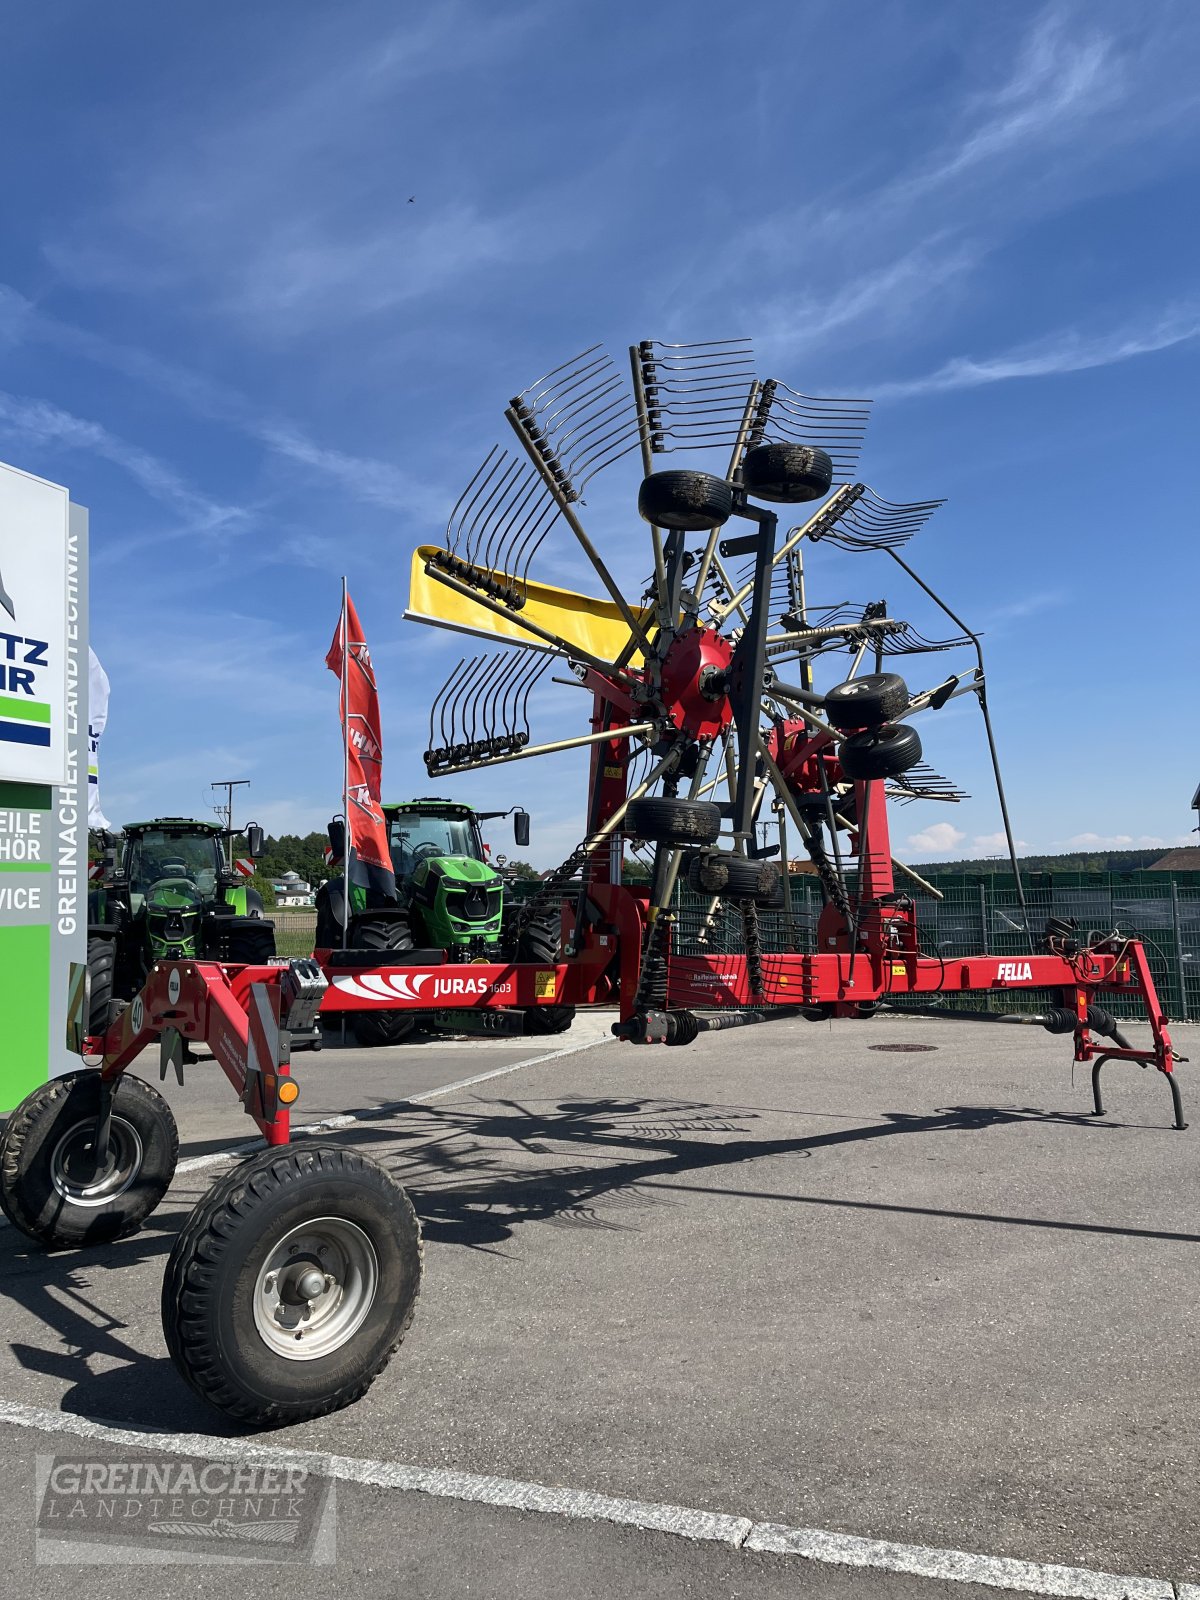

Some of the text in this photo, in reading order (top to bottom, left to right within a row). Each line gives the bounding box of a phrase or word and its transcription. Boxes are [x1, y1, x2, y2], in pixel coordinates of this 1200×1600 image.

[58, 749, 78, 935] GREINACHER
[997, 962, 1033, 981] FELLA
[433, 978, 512, 998] JURAS 1603
[132, 1001, 142, 1028] 40
